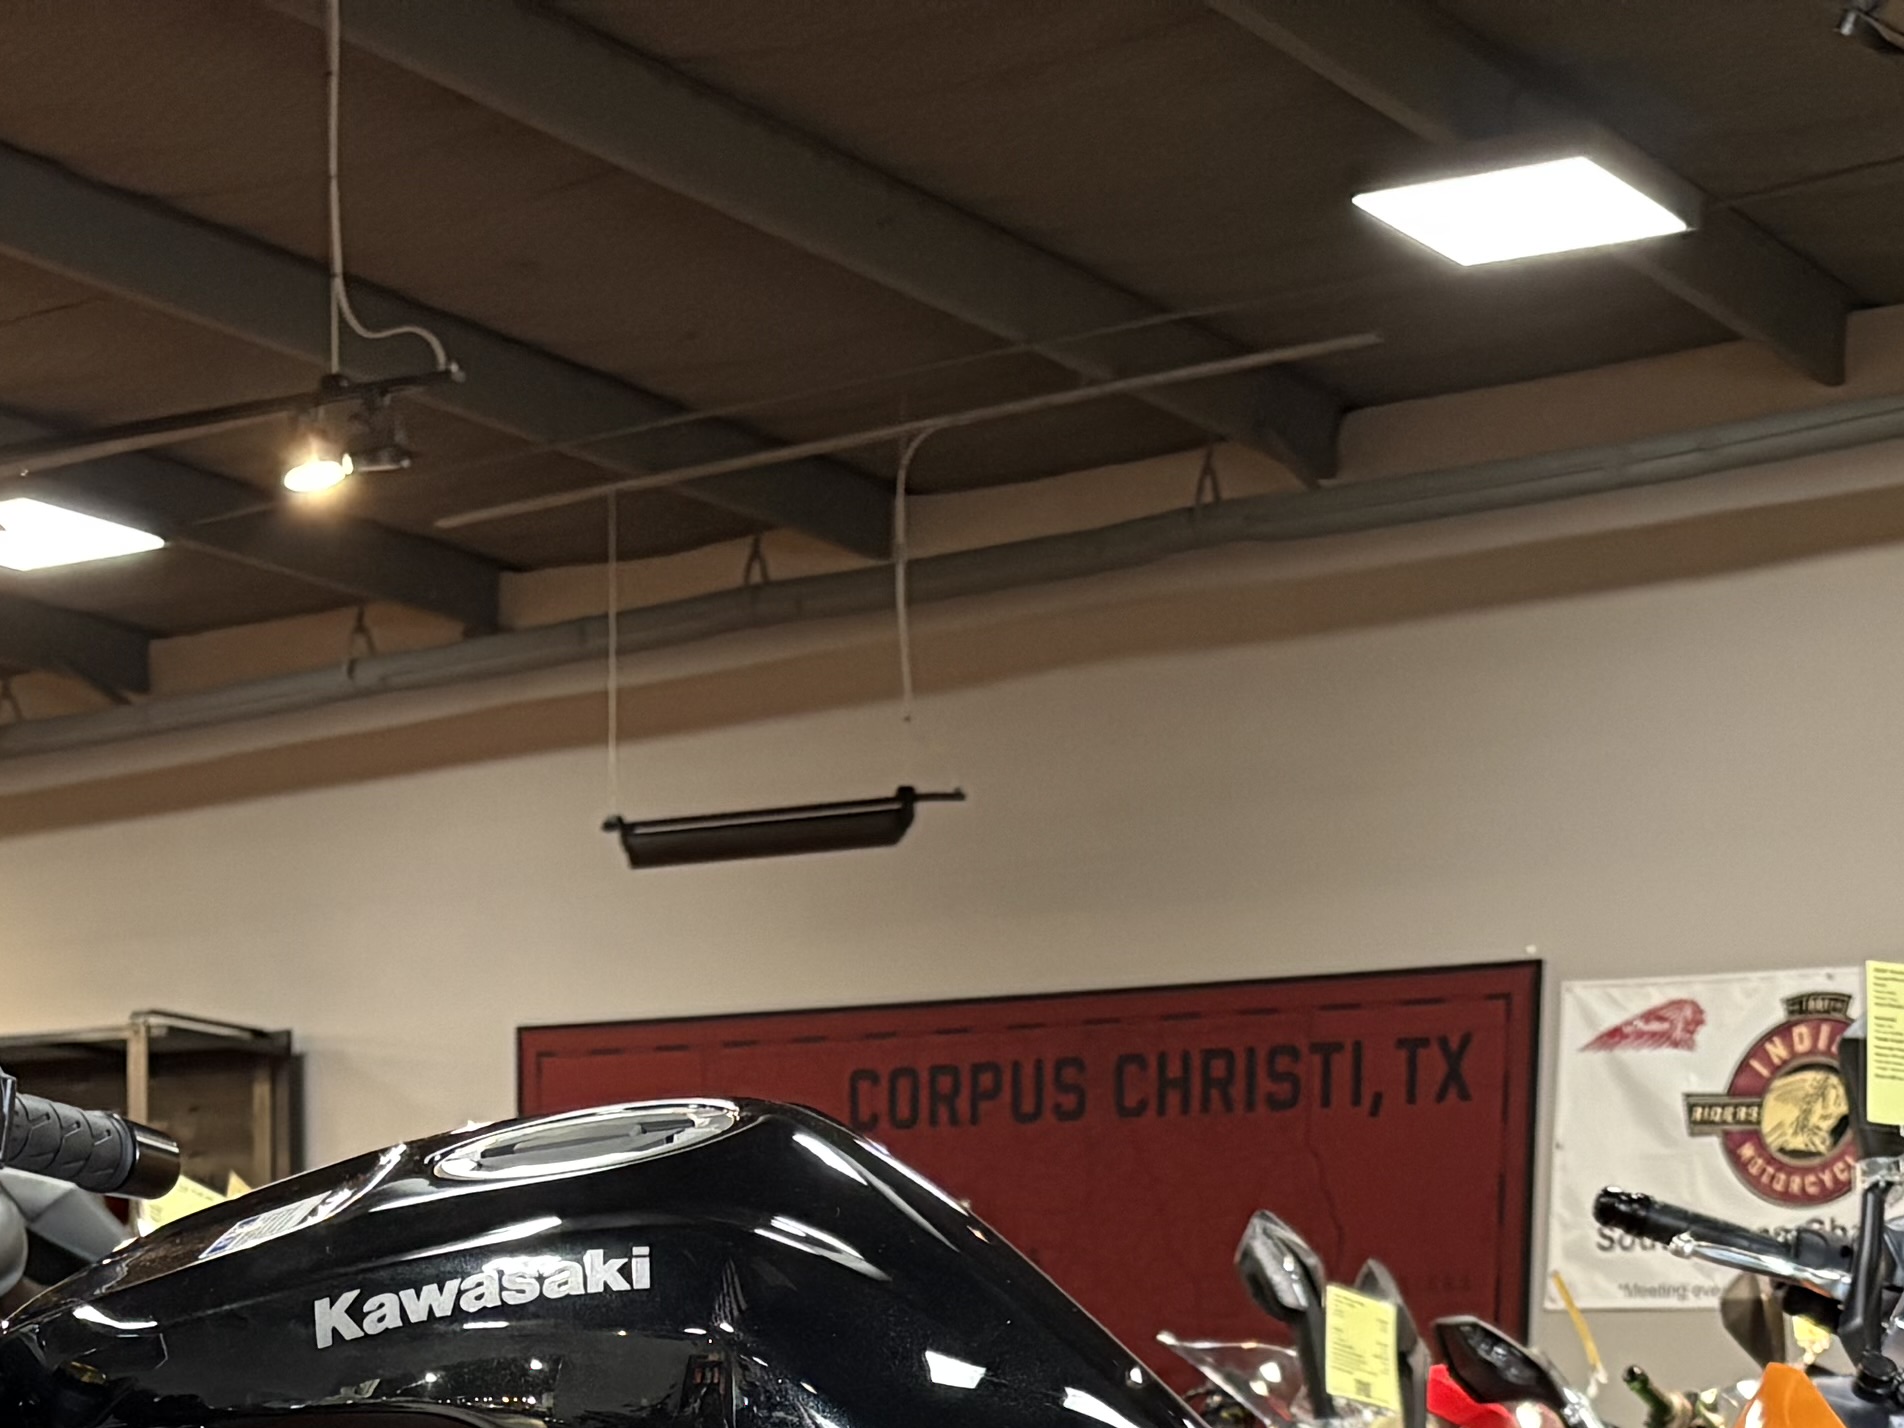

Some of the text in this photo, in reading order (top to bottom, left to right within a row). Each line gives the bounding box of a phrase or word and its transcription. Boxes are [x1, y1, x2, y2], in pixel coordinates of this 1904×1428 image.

[849, 1056, 1087, 1133] CORPUS
[1690, 1106, 1761, 1123] RIDERS
[313, 1245, 652, 1350] Kawasaki
